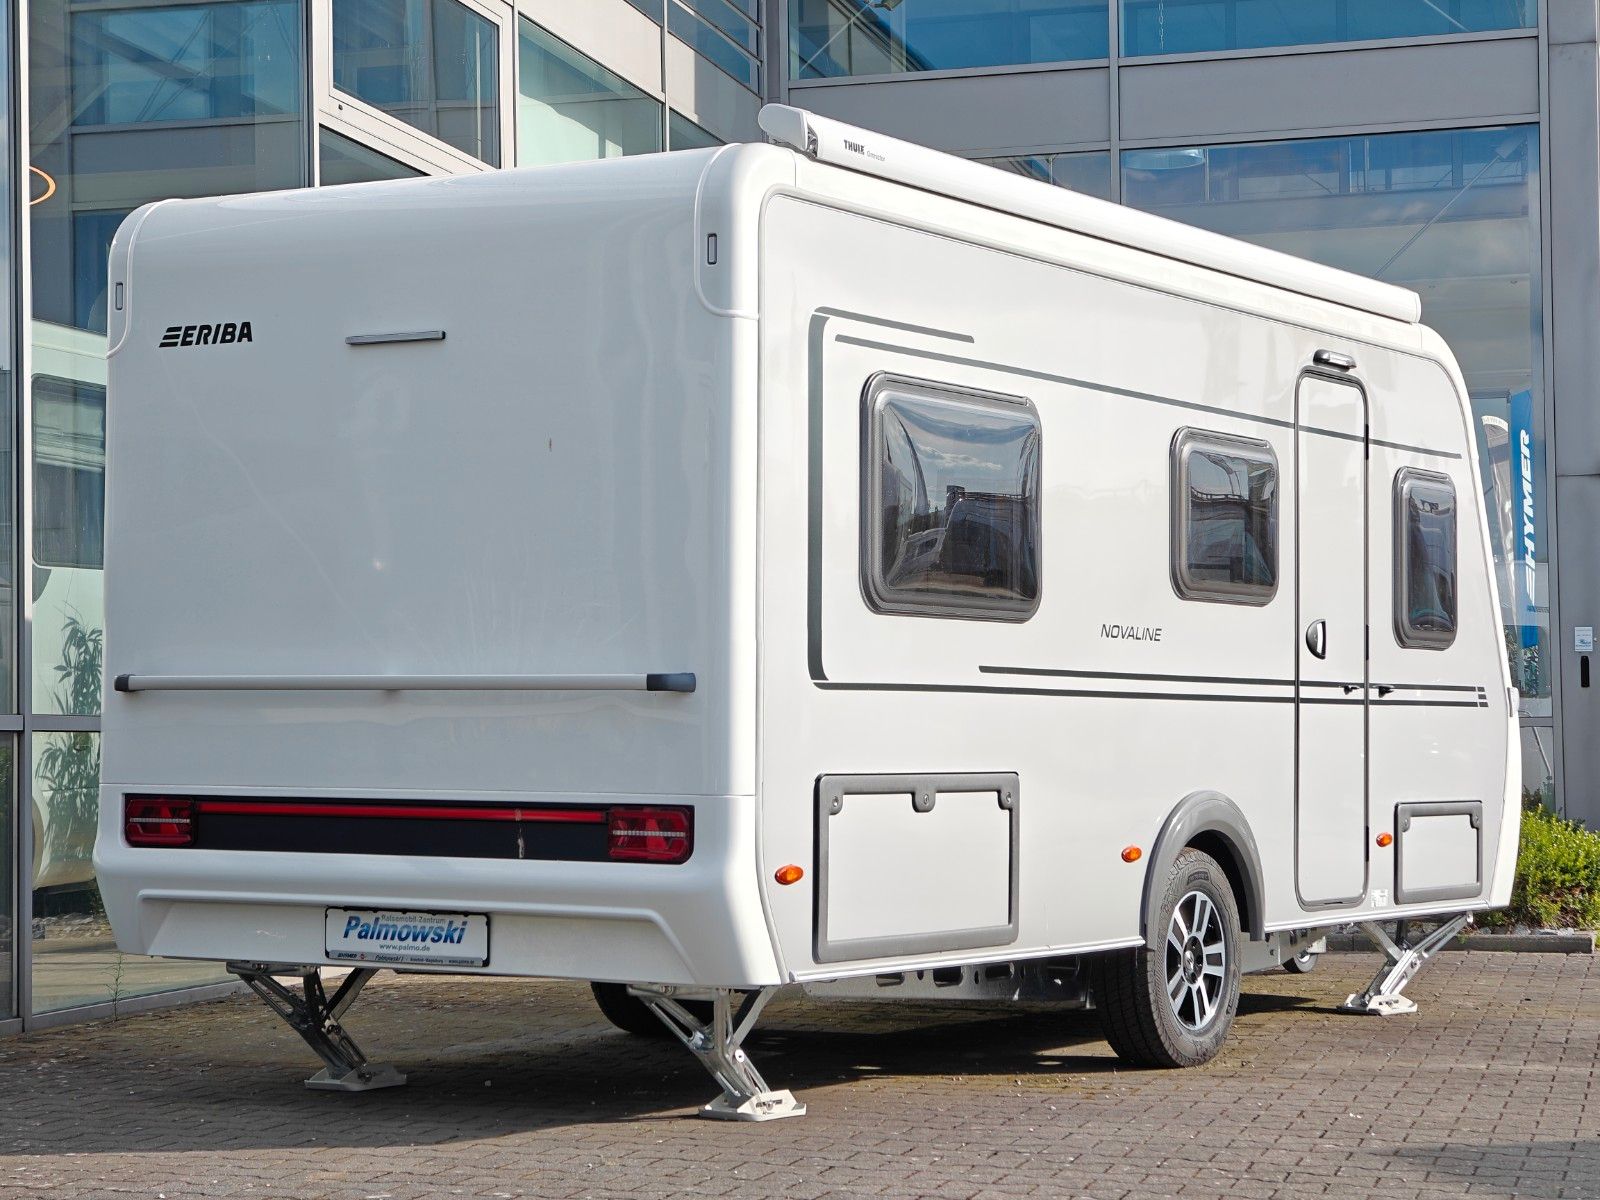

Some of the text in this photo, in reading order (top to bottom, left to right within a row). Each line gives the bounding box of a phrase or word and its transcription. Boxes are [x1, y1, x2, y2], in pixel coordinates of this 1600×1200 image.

[843, 139, 865, 155] THULE
[159, 321, 253, 348] ERIBA
[1520, 429, 1536, 607] HYMER
[1100, 623, 1162, 642] NOVALINE
[343, 916, 468, 944] Palmowski
[379, 943, 430, 952] www.palmo.de
